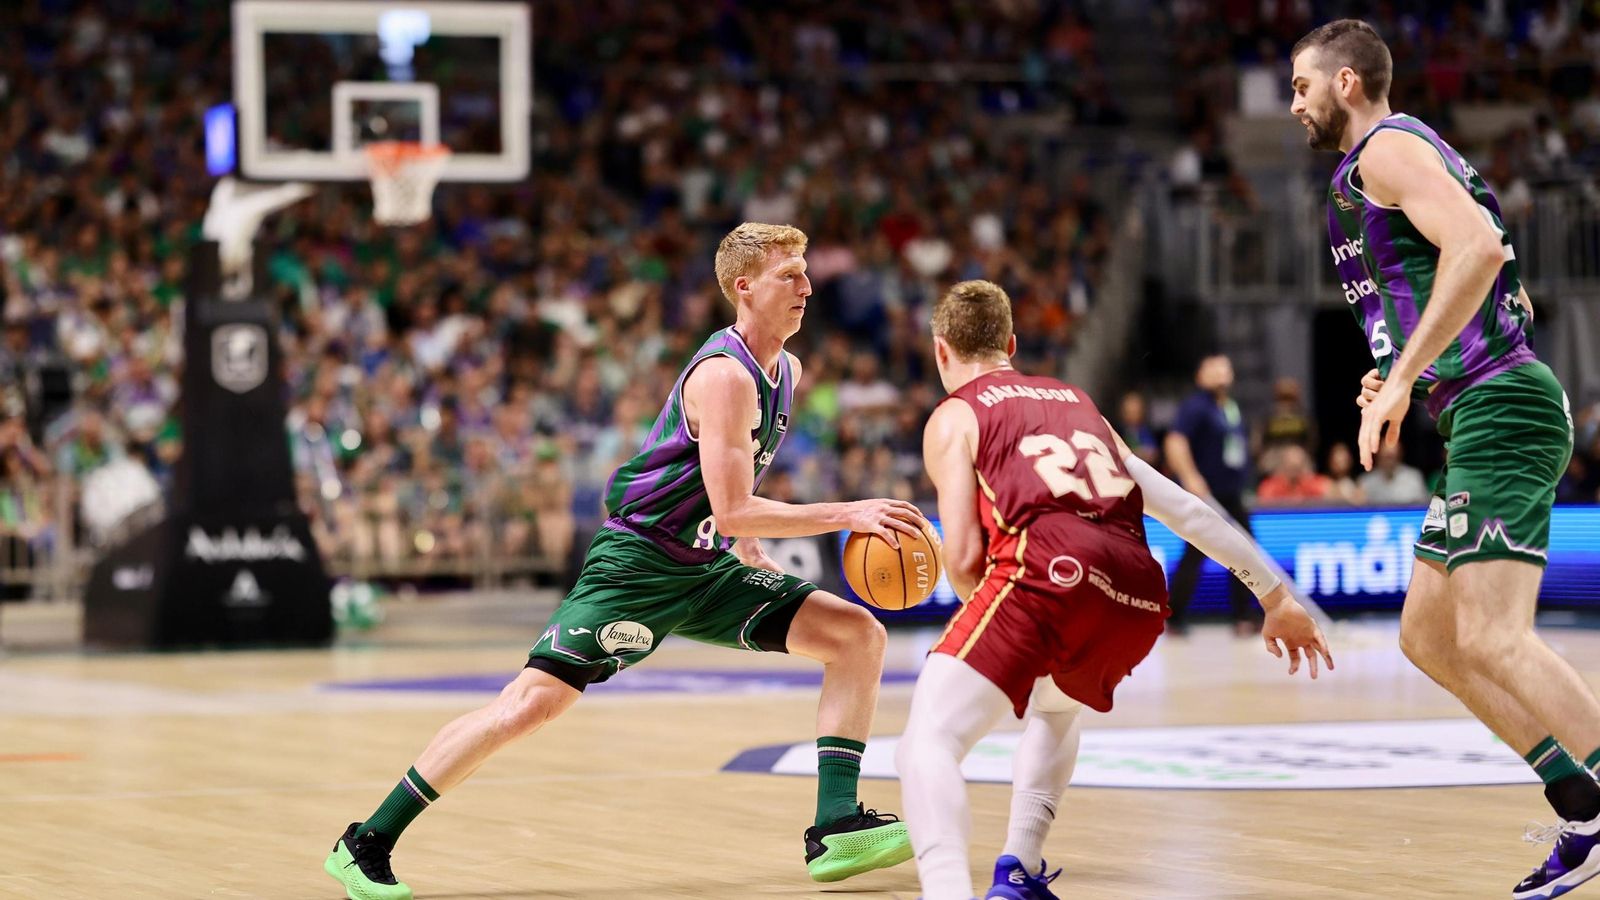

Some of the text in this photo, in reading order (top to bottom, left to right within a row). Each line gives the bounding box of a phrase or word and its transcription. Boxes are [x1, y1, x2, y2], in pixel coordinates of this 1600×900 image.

[1018, 429, 1136, 500] 22
[912, 551, 929, 589] EVO
[1116, 591, 1130, 606] DE
[1130, 596, 1161, 613] MURCIA
